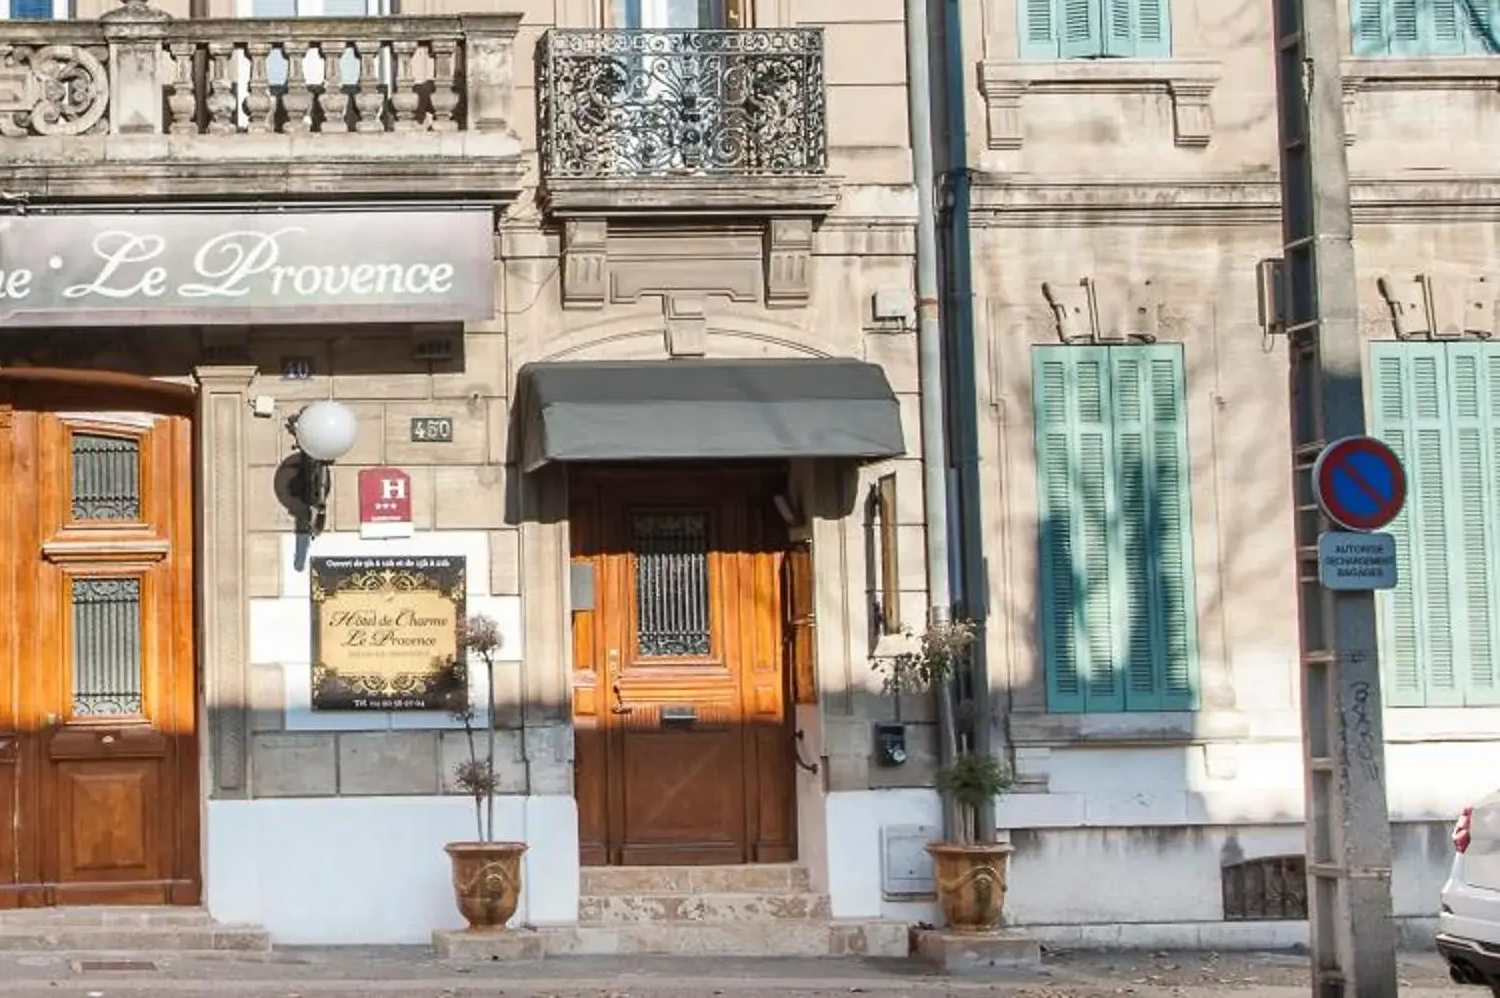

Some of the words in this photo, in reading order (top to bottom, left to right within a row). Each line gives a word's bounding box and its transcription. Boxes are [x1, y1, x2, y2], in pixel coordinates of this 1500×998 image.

[63, 230, 167, 298] Le
[177, 226, 454, 298] Provence
[414, 419, 450, 439] 450
[380, 479, 406, 499] H
[329, 609, 377, 627] Hôtel
[378, 613, 392, 627] de
[395, 608, 448, 627] Charme
[341, 629, 366, 647] Le
[369, 629, 437, 647] Provence
